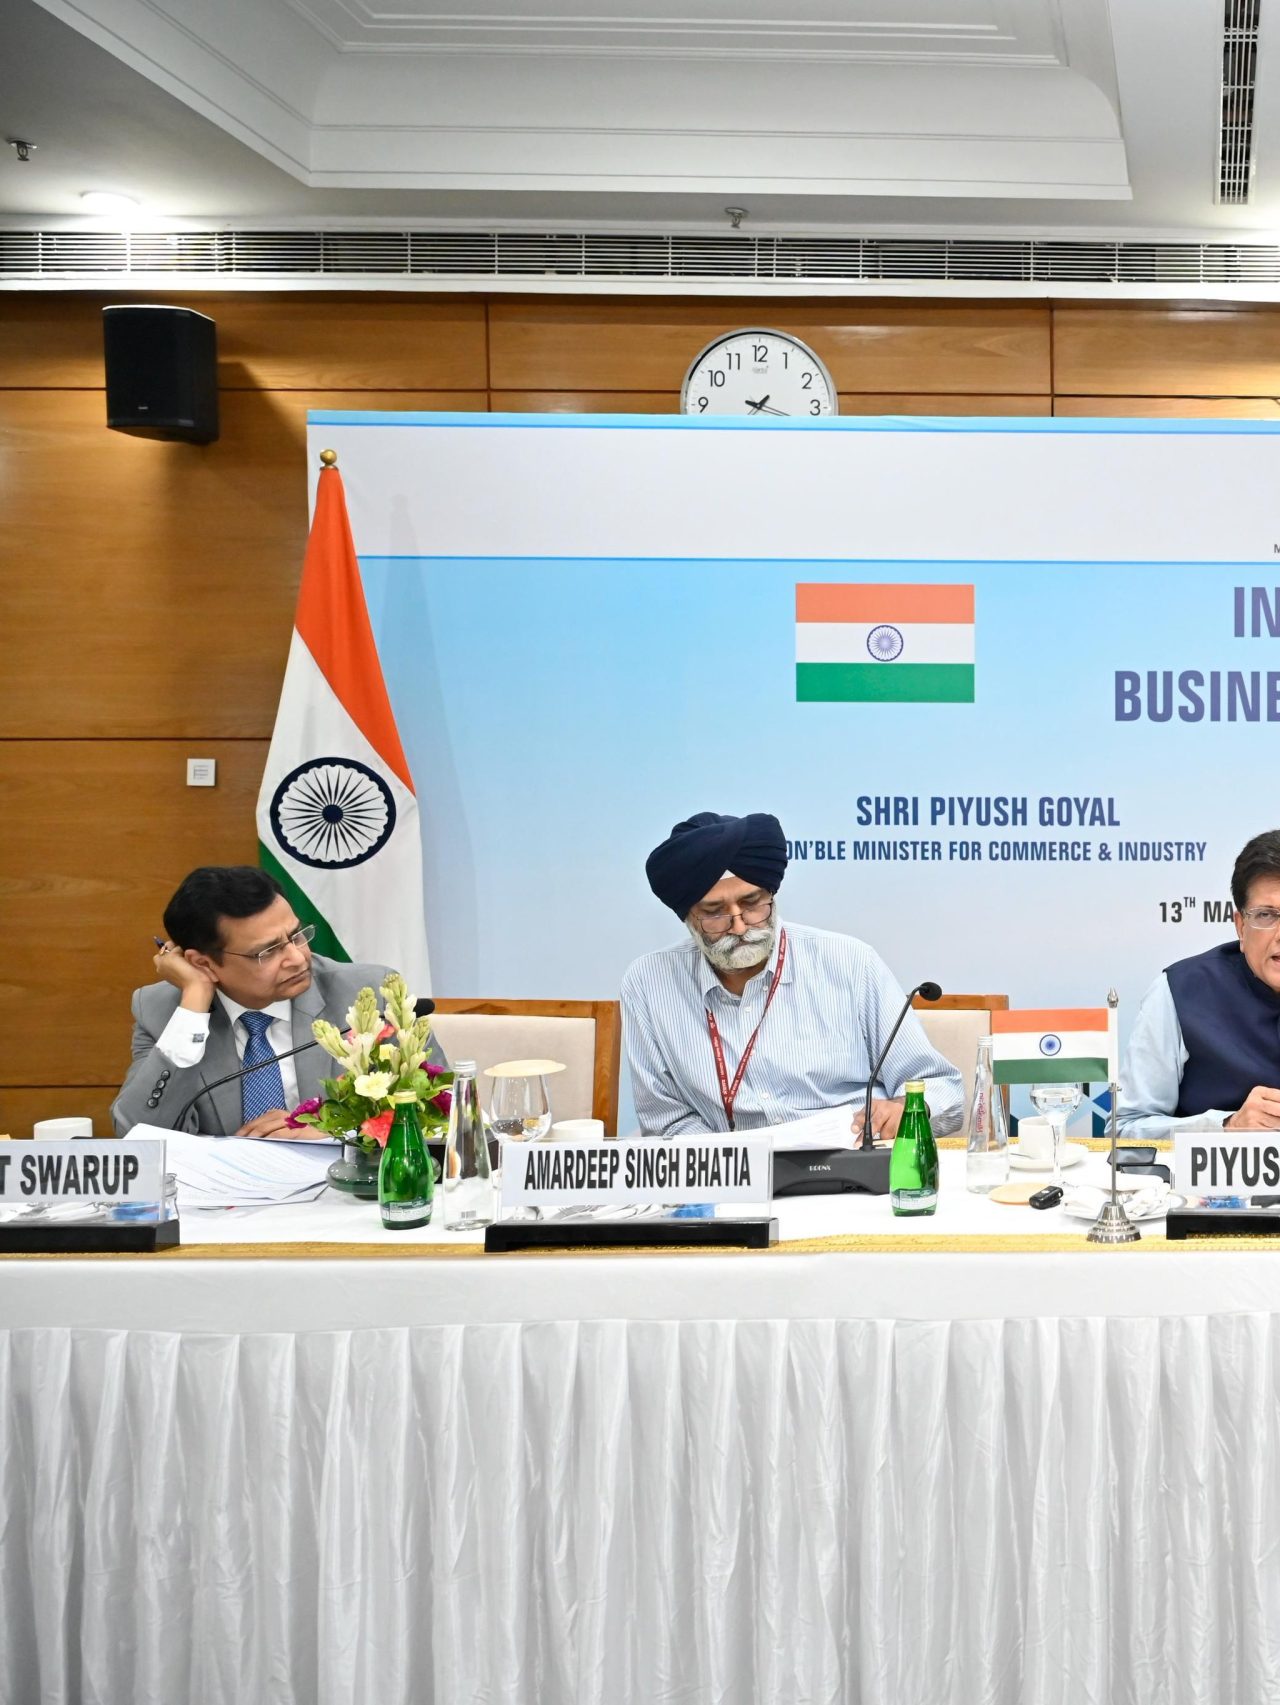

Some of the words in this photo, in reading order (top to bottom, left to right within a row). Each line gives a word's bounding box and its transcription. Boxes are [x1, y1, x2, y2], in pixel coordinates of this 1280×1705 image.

[726, 352, 741, 371] 11
[751, 344, 769, 363] 12
[781, 351, 788, 370] 1
[707, 369, 726, 388] 10
[801, 372, 813, 390] 2
[698, 396, 709, 414] 9
[809, 398, 821, 416] 3
[856, 795, 919, 826] SHRI
[930, 796, 1028, 827] PIYUSH
[1038, 796, 1121, 827] GOYAL
[853, 840, 942, 861] MINISTER
[949, 840, 982, 861] FOR
[988, 840, 1092, 862] COMMERCE
[1097, 842, 1112, 862] &
[1118, 841, 1207, 862] INDUSTRY
[1203, 900, 1235, 923] MA
[19, 1154, 139, 1196] SWARUP
[524, 1148, 620, 1191] AMARDEEP
[624, 1147, 680, 1189] SINGH
[685, 1146, 751, 1188] BHATIA
